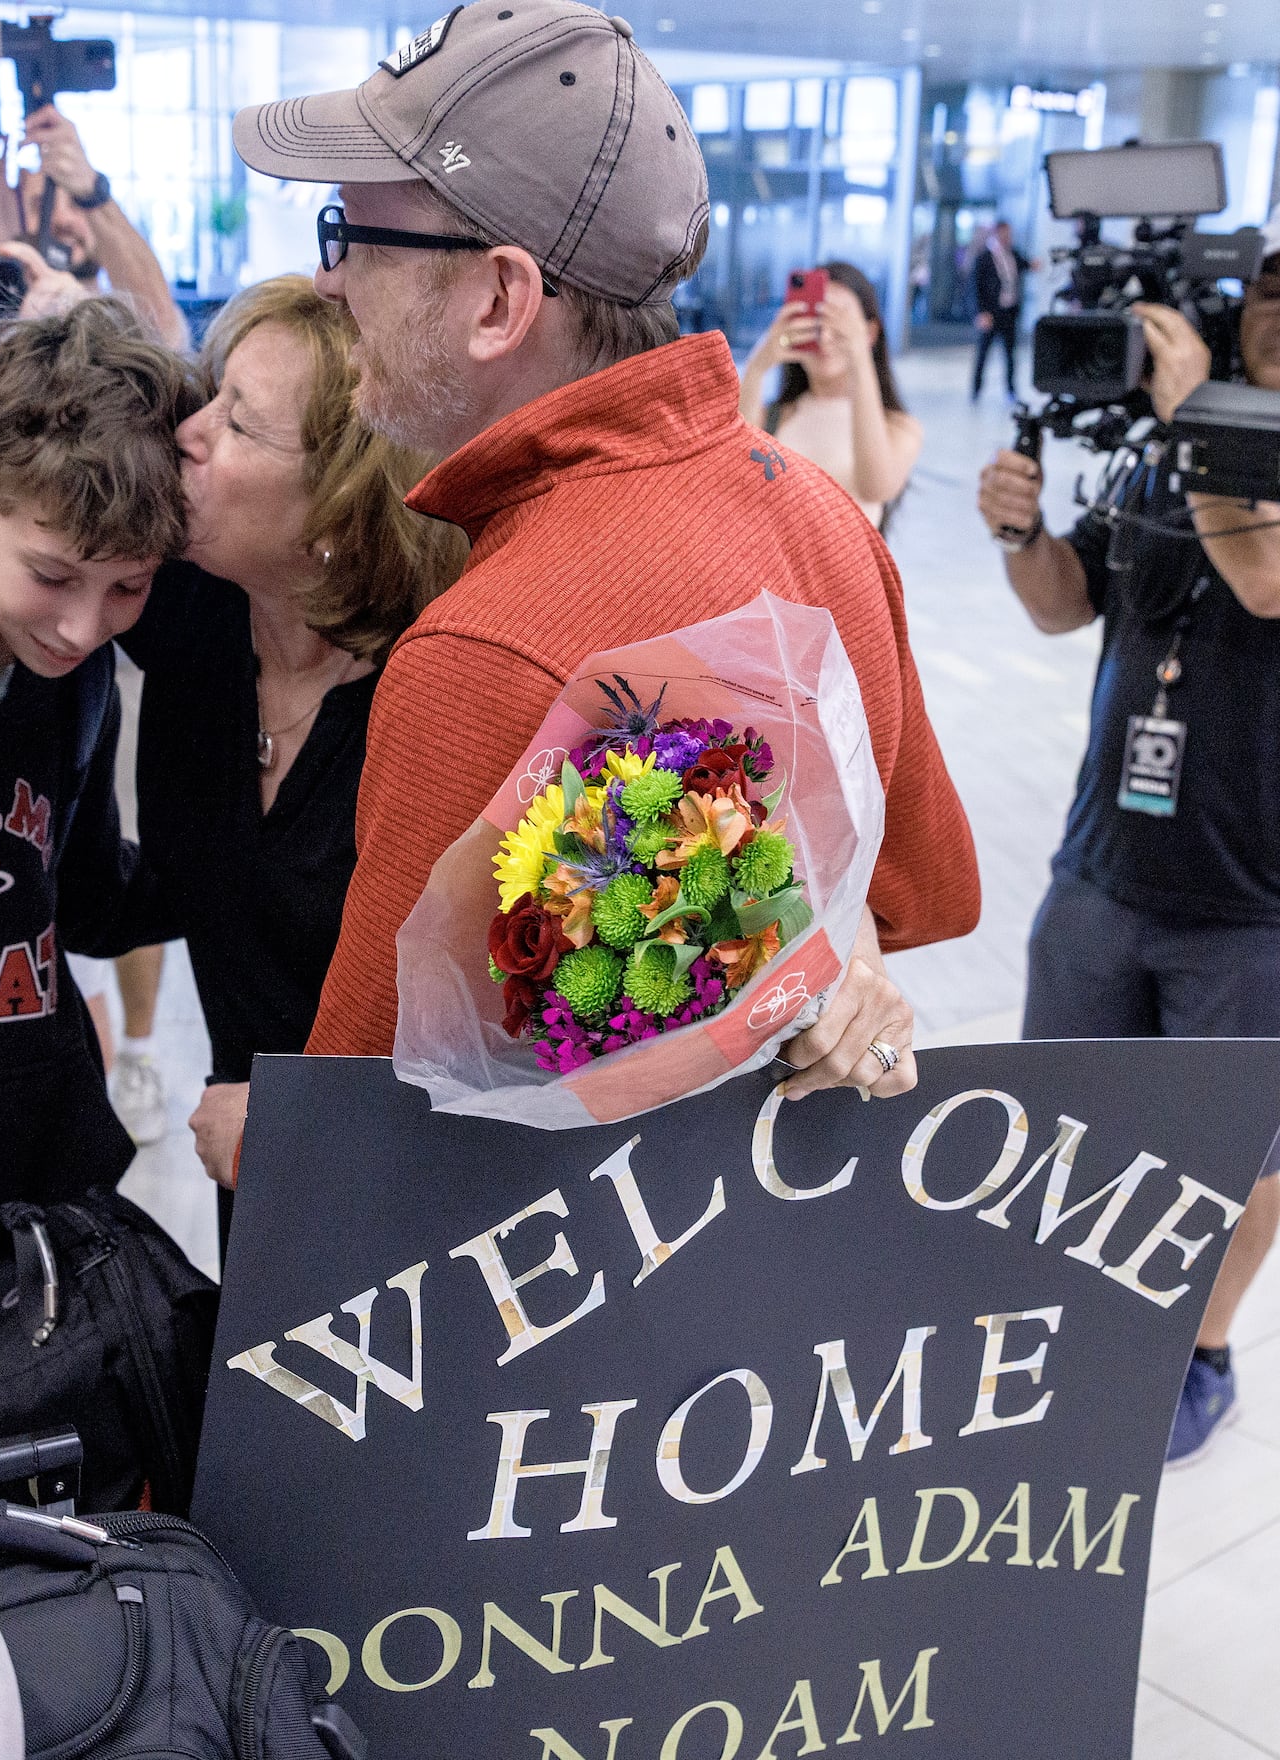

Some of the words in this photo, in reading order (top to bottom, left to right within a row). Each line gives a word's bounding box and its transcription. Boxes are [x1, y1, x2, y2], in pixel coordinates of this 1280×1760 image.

[227, 1081, 1244, 1442] WELCOME
[466, 1305, 1064, 1540] HOME
[819, 1482, 1141, 1588] ADAM
